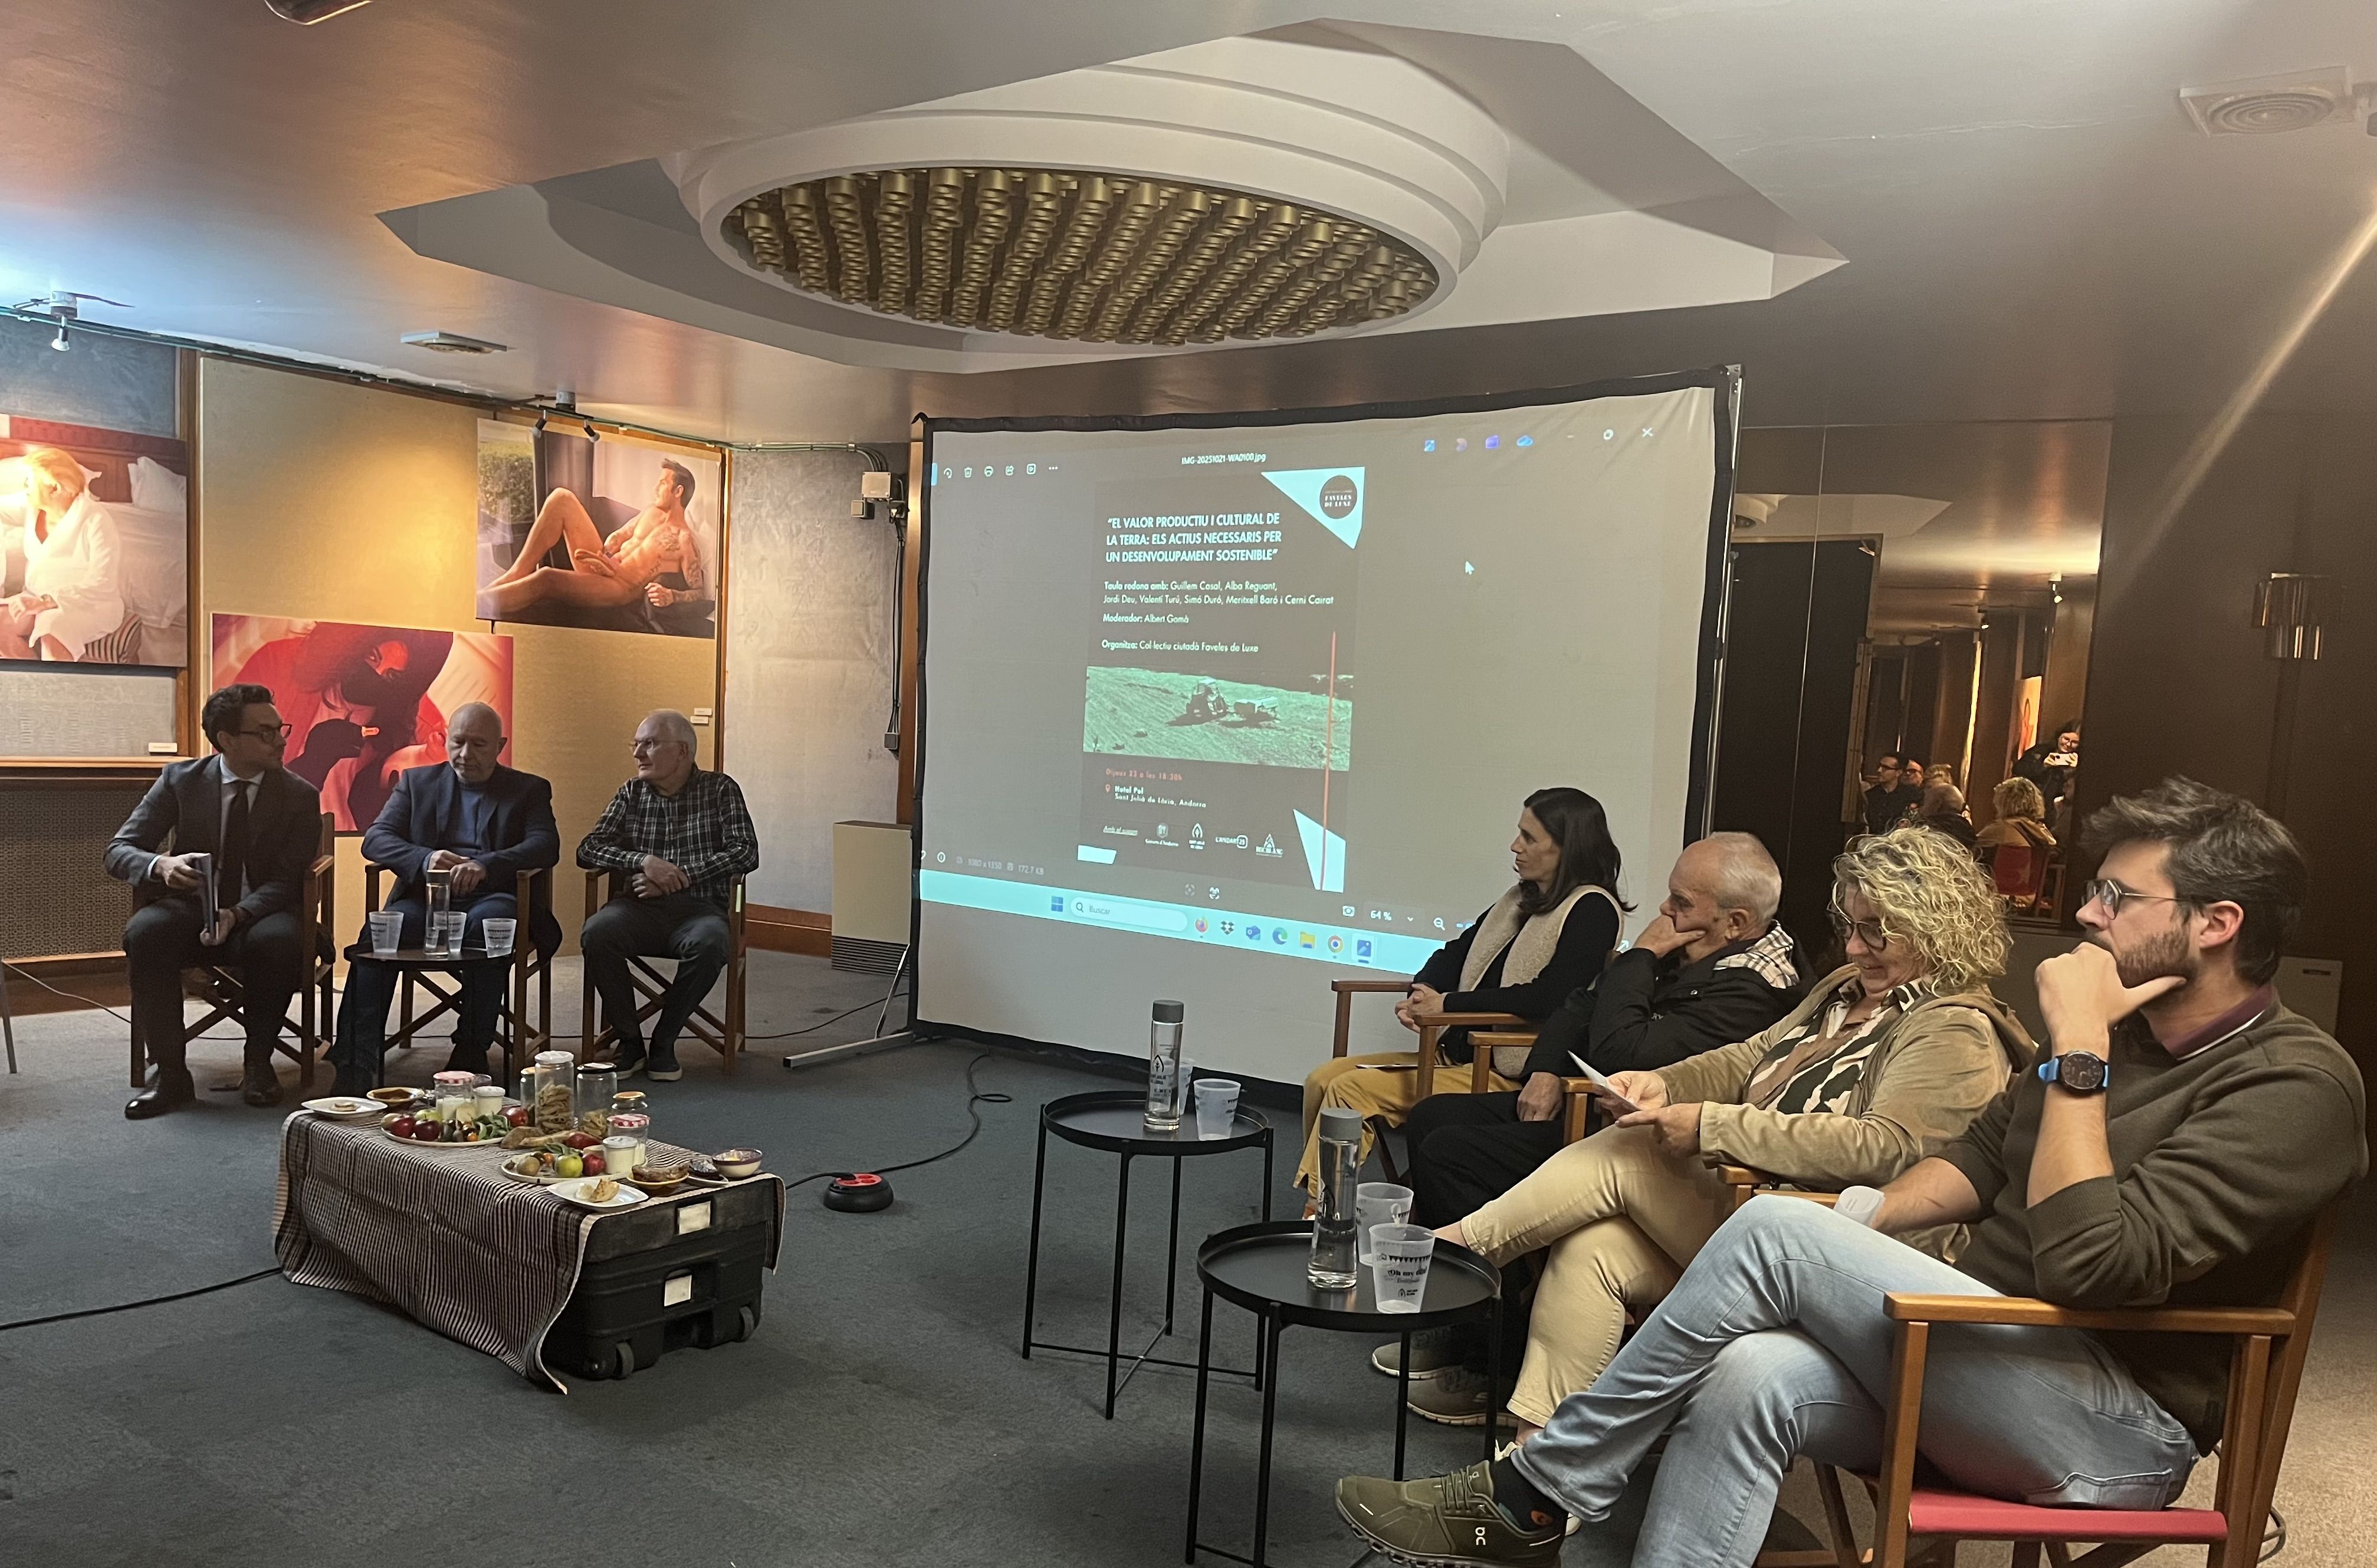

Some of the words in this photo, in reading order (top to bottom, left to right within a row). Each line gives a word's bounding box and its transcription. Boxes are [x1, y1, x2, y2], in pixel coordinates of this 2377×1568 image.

[1123, 517, 1154, 528] VALOR
[1155, 515, 1208, 528] PRODUCTIU
[1211, 514, 1214, 526] I
[1216, 513, 1264, 526] CULTURAL
[1266, 512, 1280, 524] DE
[1106, 535, 1118, 545] LA
[1119, 534, 1150, 545] TERRA:
[1151, 534, 1167, 545] ELS
[1168, 532, 1201, 545] ACTIUS
[1204, 531, 1262, 544] NECESSARIS
[1264, 531, 1282, 543] PER
[1106, 551, 1120, 563] UN
[1122, 550, 1214, 563] DESENVOLUPAMENT
[1104, 580, 1122, 590] Taula
[1124, 580, 1149, 590] rodona
[1150, 580, 1168, 590] amb:
[1170, 581, 1198, 590] Guillem
[1199, 581, 1223, 591] Casal,
[1224, 580, 1243, 590] Alba
[1245, 581, 1277, 593] Reguant,
[1103, 594, 1120, 604] Jordi
[1139, 594, 1163, 603] Valentí
[1165, 595, 1181, 605] Turú,
[1184, 594, 1201, 604] Simó
[1204, 594, 1223, 605] Duró,
[1226, 594, 1258, 604] Meritxell
[1260, 594, 1278, 604] Baró
[1279, 596, 1283, 604] i
[1285, 594, 1306, 604] Cerni
[1308, 594, 1334, 604] Cairat
[1102, 613, 1142, 623] Moderador:
[1144, 614, 1165, 623] Albert
[1101, 639, 1138, 650] Organitza:
[1173, 642, 1199, 650] ciutadà
[1201, 642, 1228, 652] Faveles
[1230, 642, 1240, 652] de
[1242, 643, 1259, 653] Luxe
[1115, 785, 1131, 794] Hotel
[1179, 799, 1207, 808] Andorra
[988, 861, 1002, 870] 1350
[1019, 865, 1034, 874] 172.7
[1089, 906, 1110, 915] Buscar
